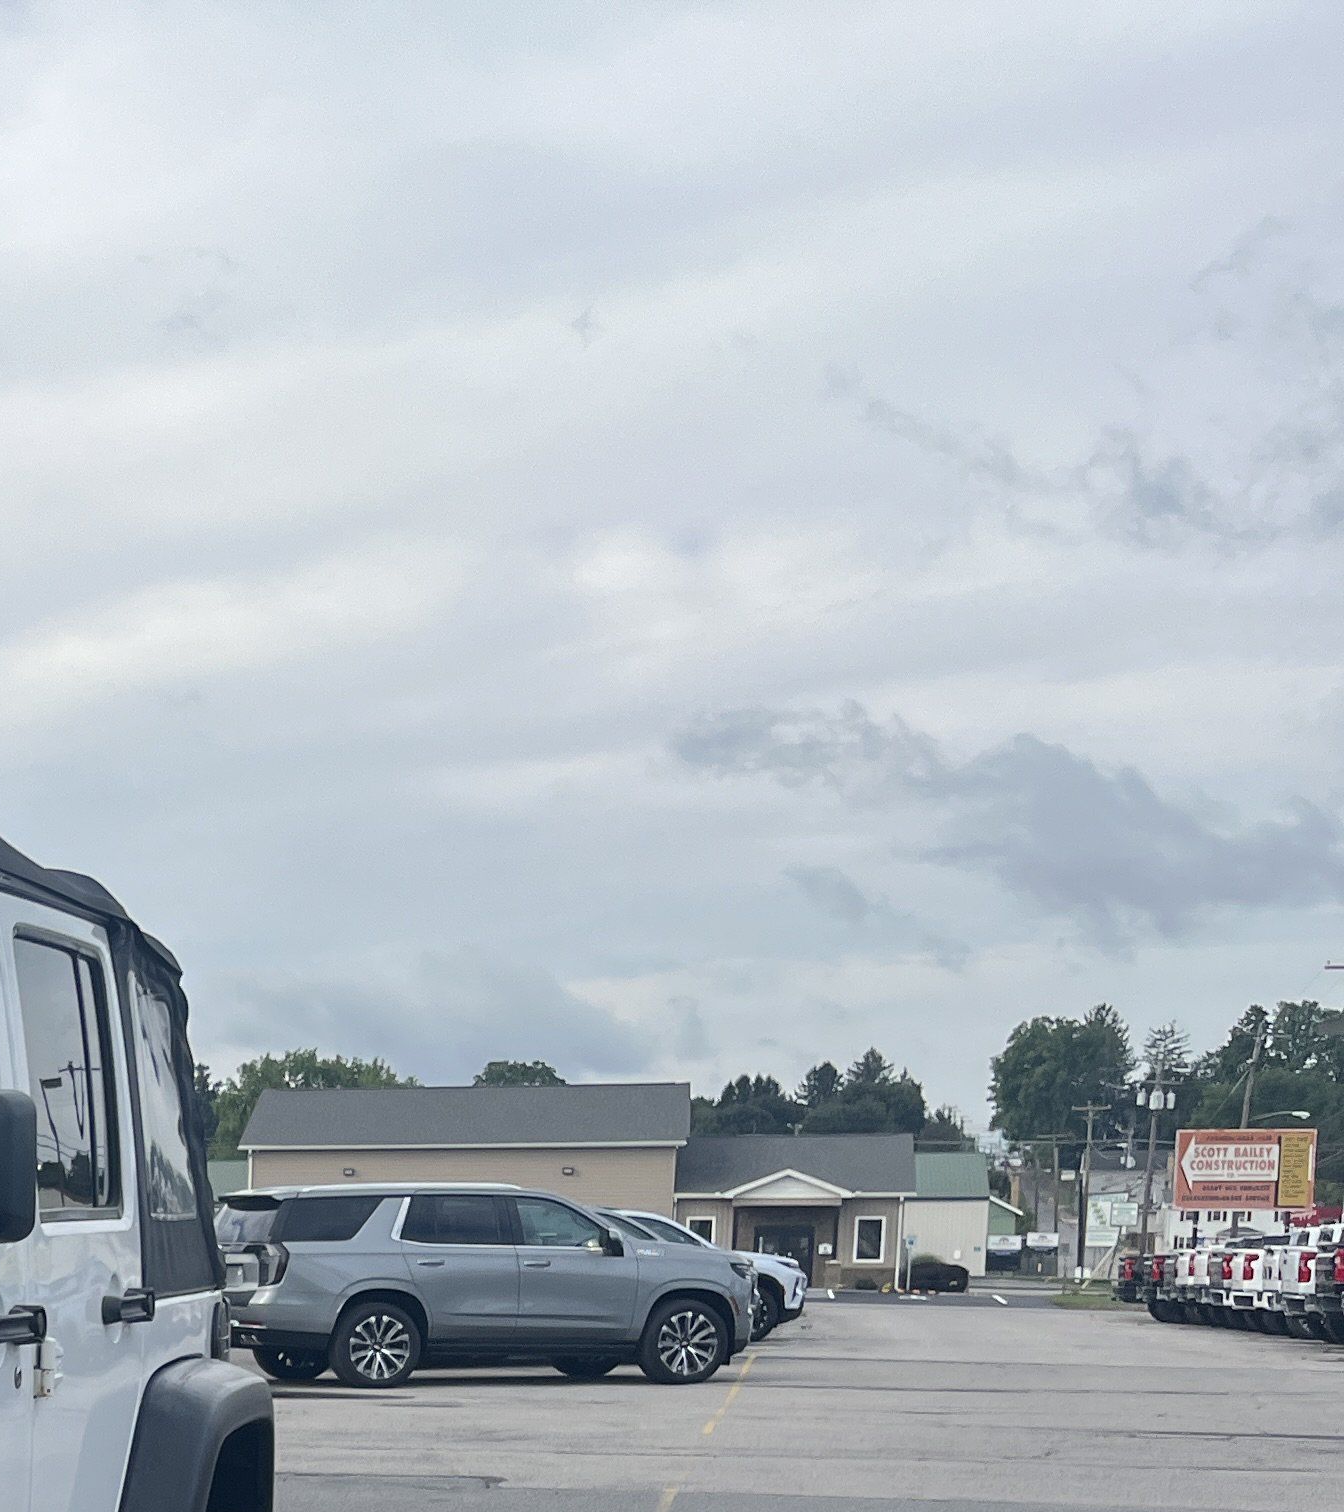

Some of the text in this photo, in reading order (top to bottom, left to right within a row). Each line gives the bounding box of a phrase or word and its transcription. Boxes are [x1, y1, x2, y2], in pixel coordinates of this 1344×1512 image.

[1194, 1147, 1273, 1158] SCOTT BAILEY
[1189, 1159, 1275, 1171] CONSTRUCTION
